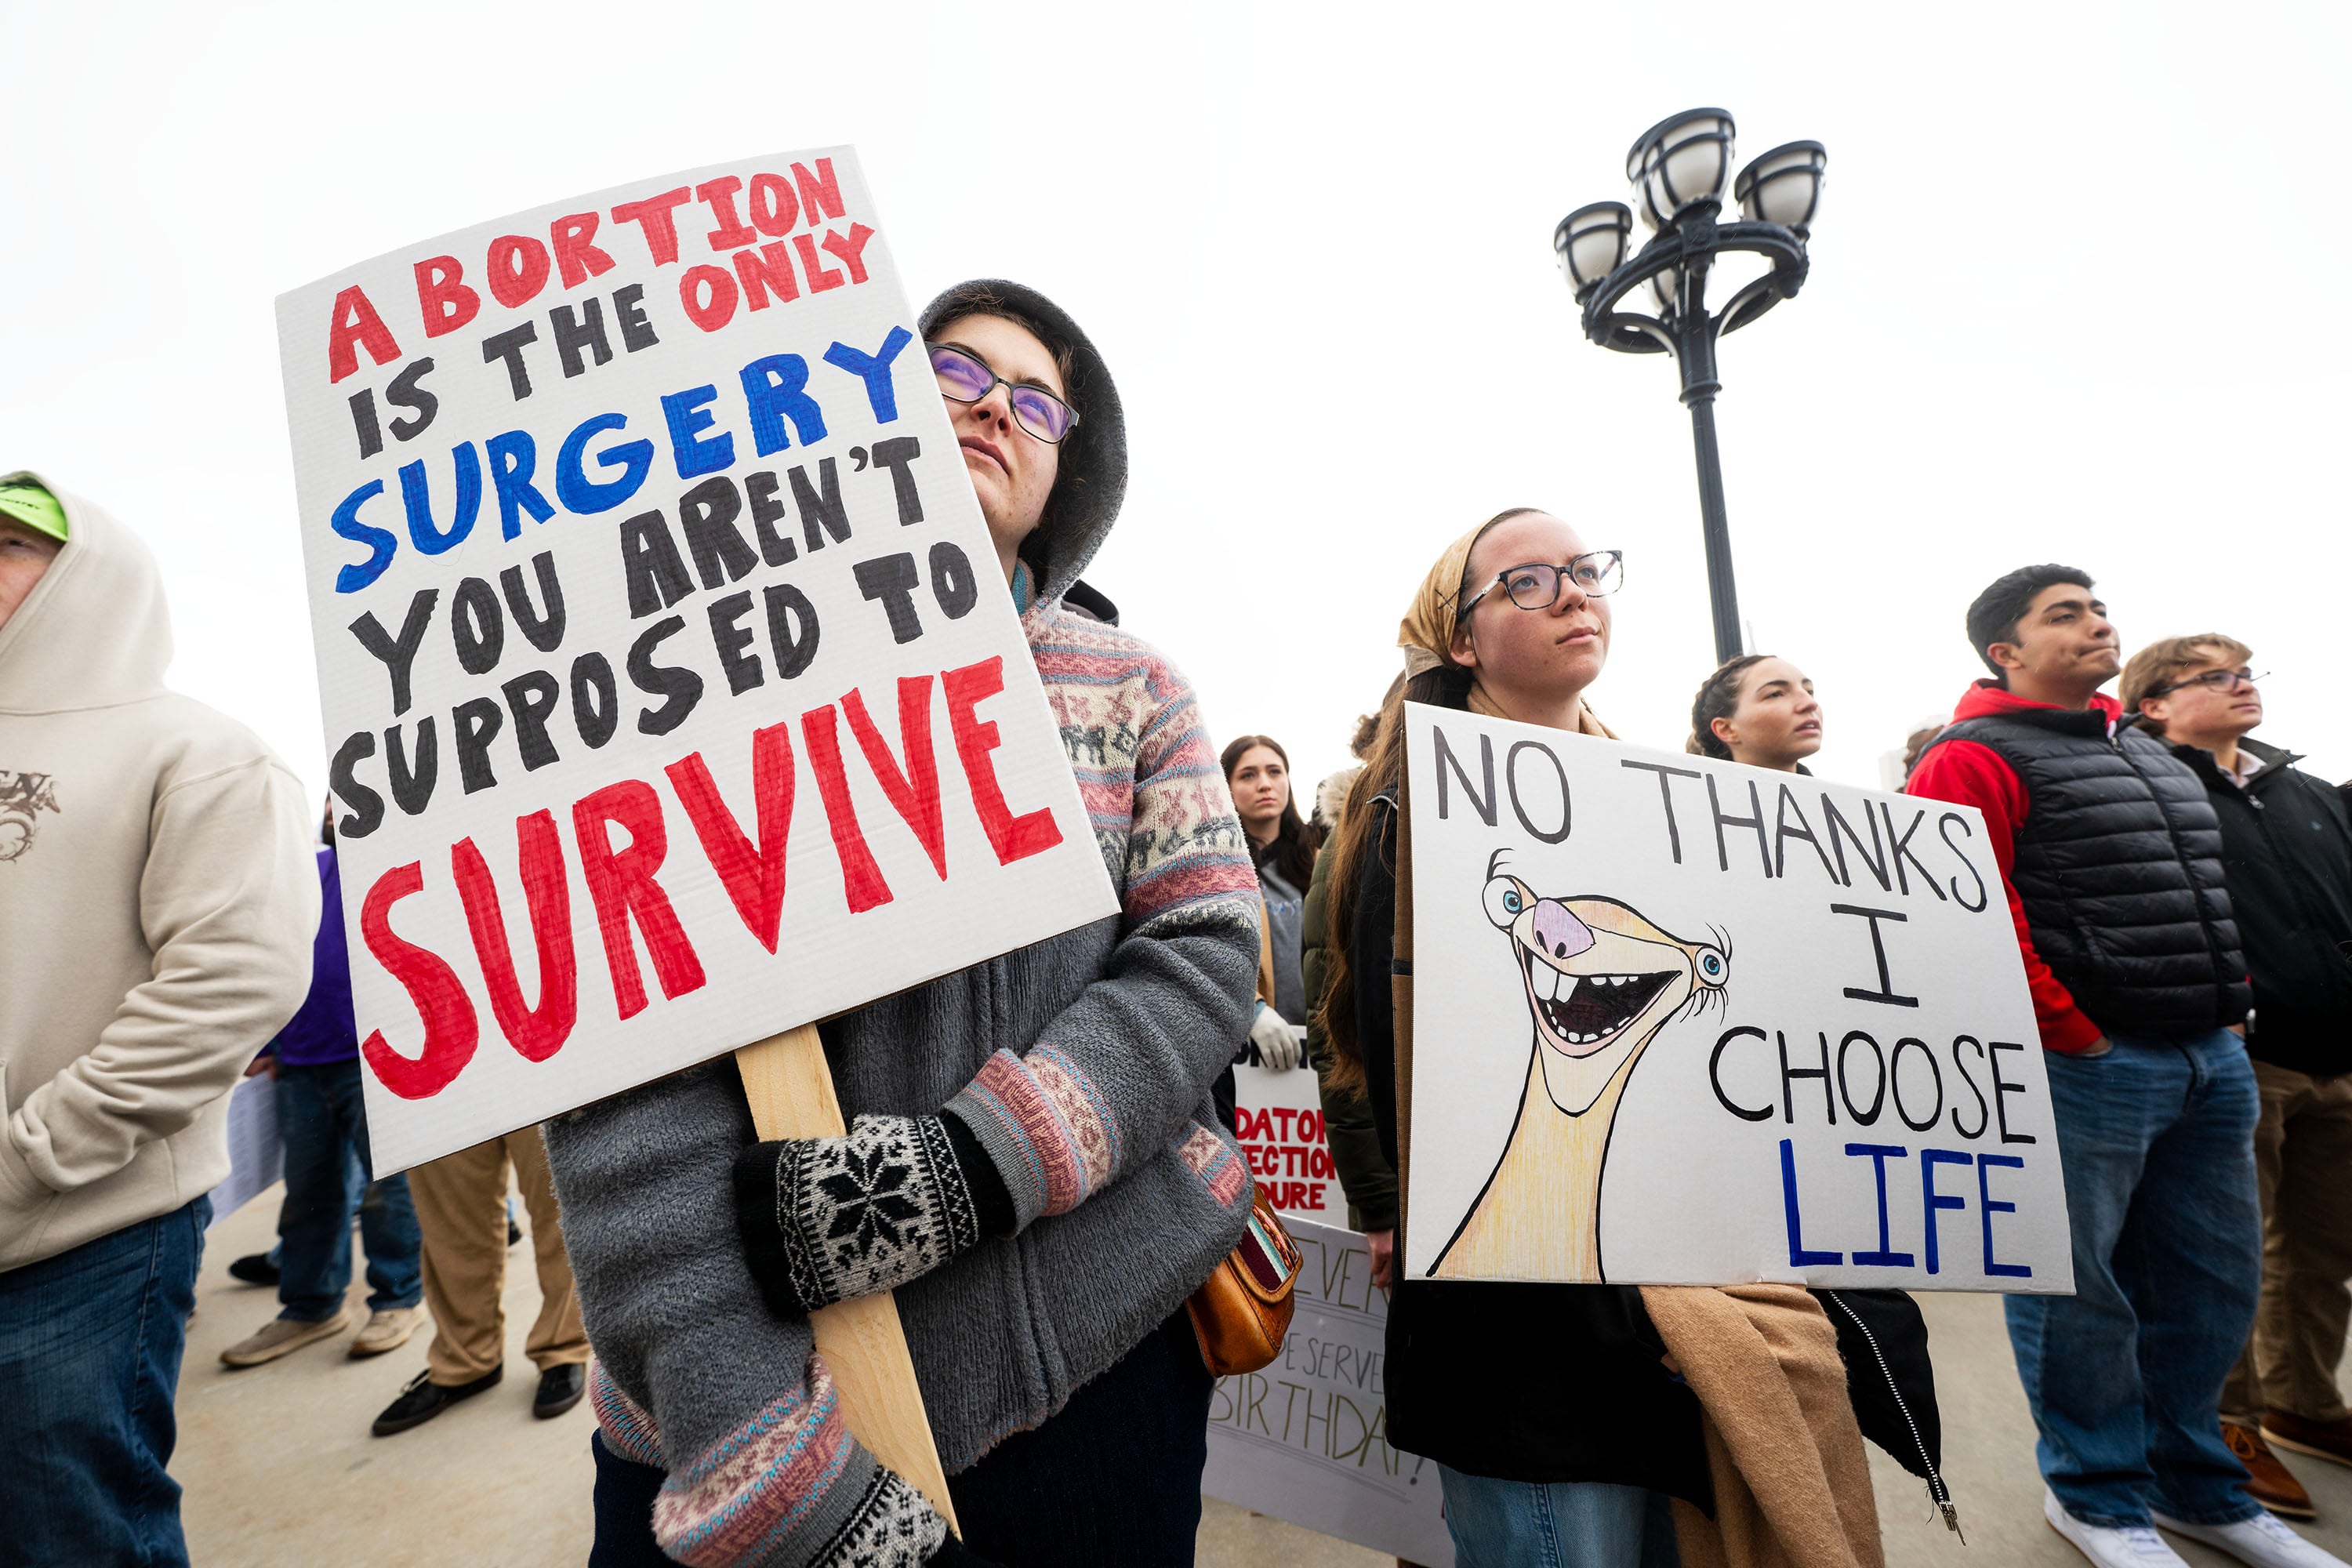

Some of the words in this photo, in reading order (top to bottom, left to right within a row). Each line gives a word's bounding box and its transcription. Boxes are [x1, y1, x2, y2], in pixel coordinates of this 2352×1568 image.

[328, 157, 847, 384] ABORTION
[347, 355, 440, 461] IS
[481, 282, 661, 403] THE
[678, 221, 876, 334] ONLY
[329, 325, 914, 595] SURGERY
[347, 549, 568, 719] YOU
[619, 435, 925, 620] AREN'T
[336, 583, 822, 840] SUPPOSED
[851, 540, 979, 645] TO
[359, 654, 1065, 1102] SURVIVE
[1432, 724, 1572, 846] NO
[1620, 758, 1988, 914] THANKS
[1829, 902, 1920, 1009] I
[1240, 1144, 1337, 1180] ECTIO
[1708, 1025, 2038, 1145] CHOOSE
[1778, 1137, 2034, 1279] LIFE
[1278, 1332, 1385, 1396] ESERVE
